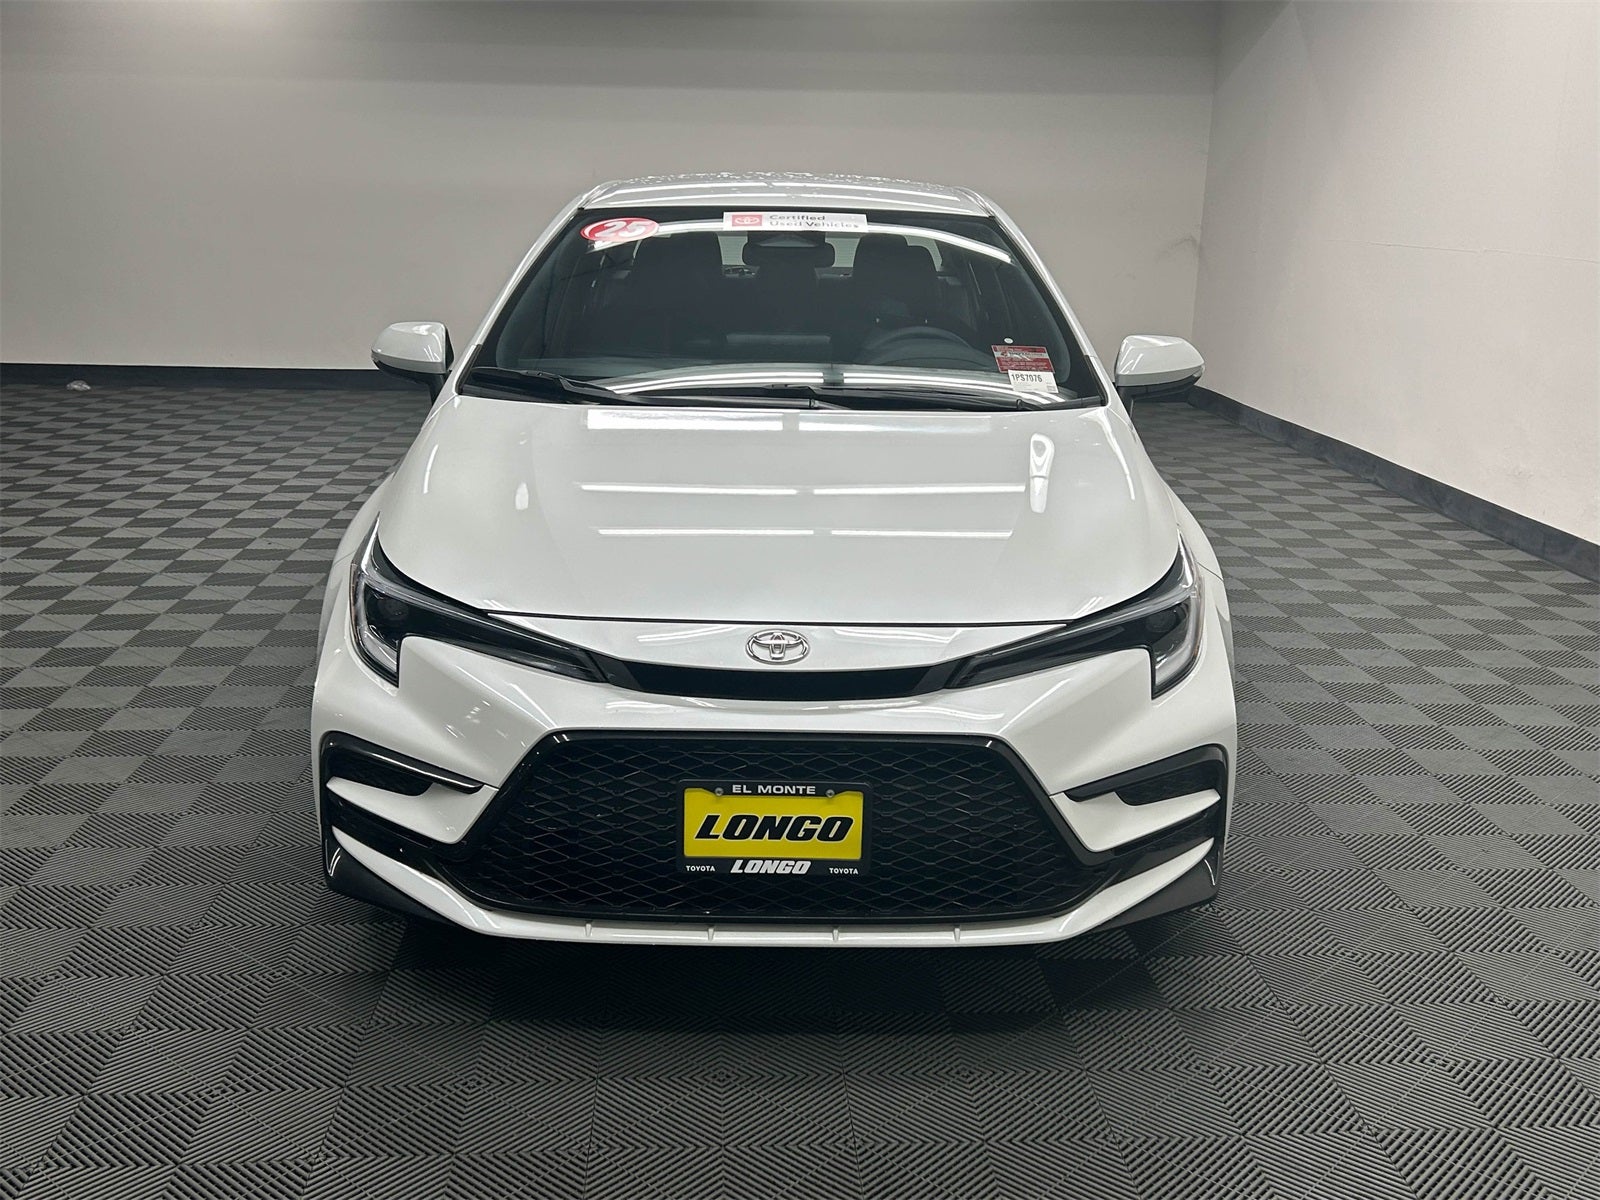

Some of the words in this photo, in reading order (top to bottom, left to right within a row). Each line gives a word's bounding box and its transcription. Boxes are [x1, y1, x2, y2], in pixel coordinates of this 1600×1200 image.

[594, 220, 653, 238] 25
[804, 221, 860, 229] Vehicles
[732, 784, 753, 794] EL
[757, 784, 816, 795] MONTE
[694, 813, 855, 843] LONGO
[686, 865, 716, 873] TOYOTA
[730, 859, 812, 875] LONGO
[829, 867, 859, 875] TOYOTA
